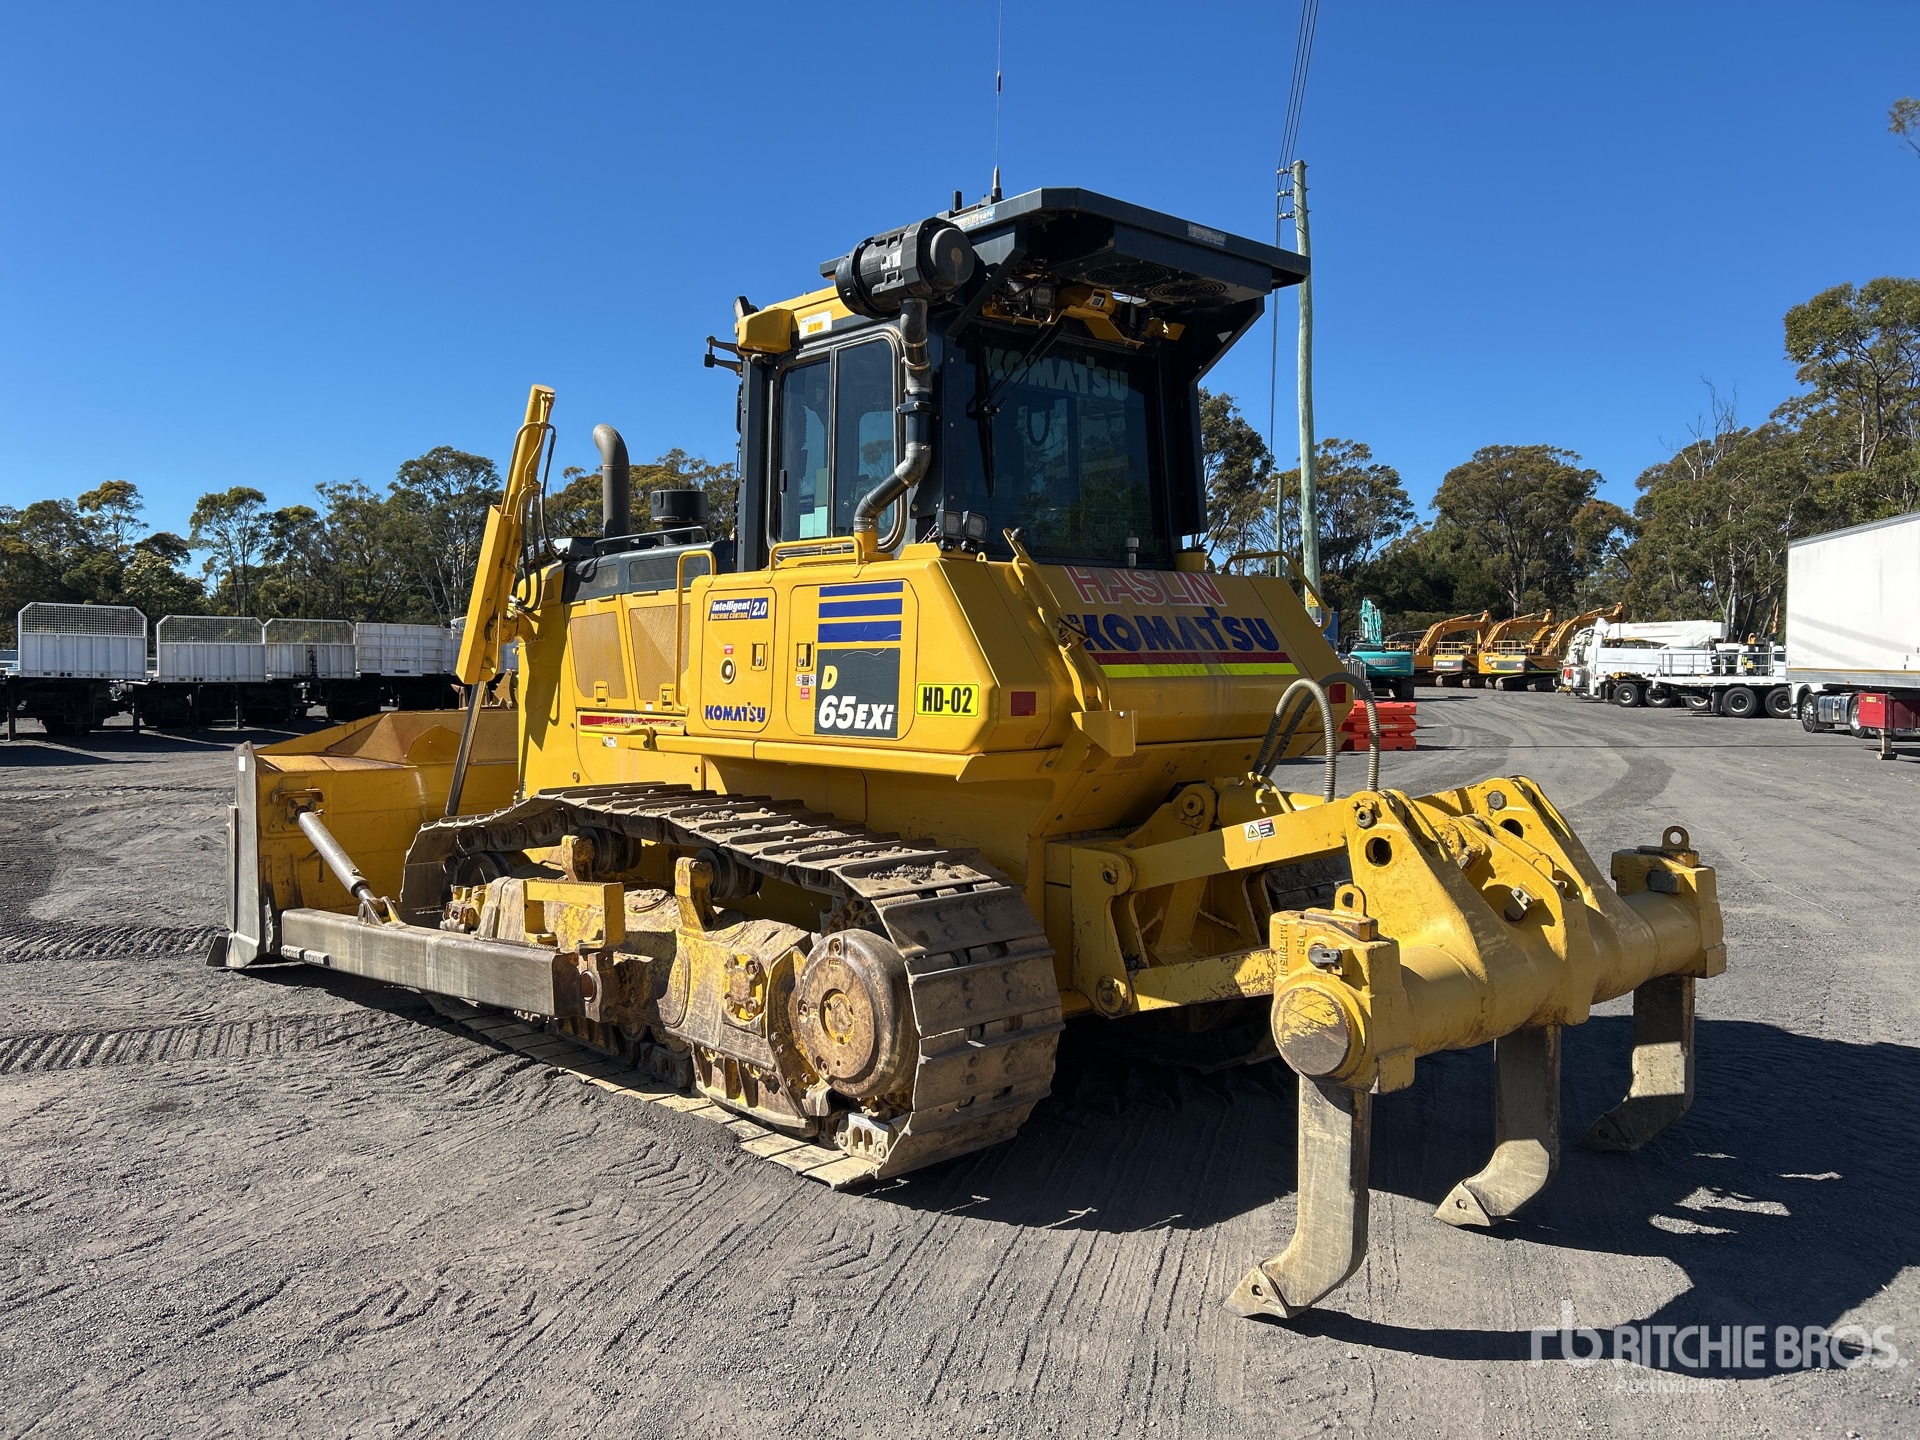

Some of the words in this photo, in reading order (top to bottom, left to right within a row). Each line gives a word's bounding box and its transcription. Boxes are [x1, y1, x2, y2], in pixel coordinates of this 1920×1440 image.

[984, 346, 1129, 400] KOMATSU
[1062, 566, 1228, 607] HASLIN
[752, 601, 768, 616] 2.0
[1066, 607, 1280, 651] KOMATSU
[820, 665, 838, 690] D
[705, 702, 766, 723] KOMATSU
[922, 685, 973, 714] HD-02
